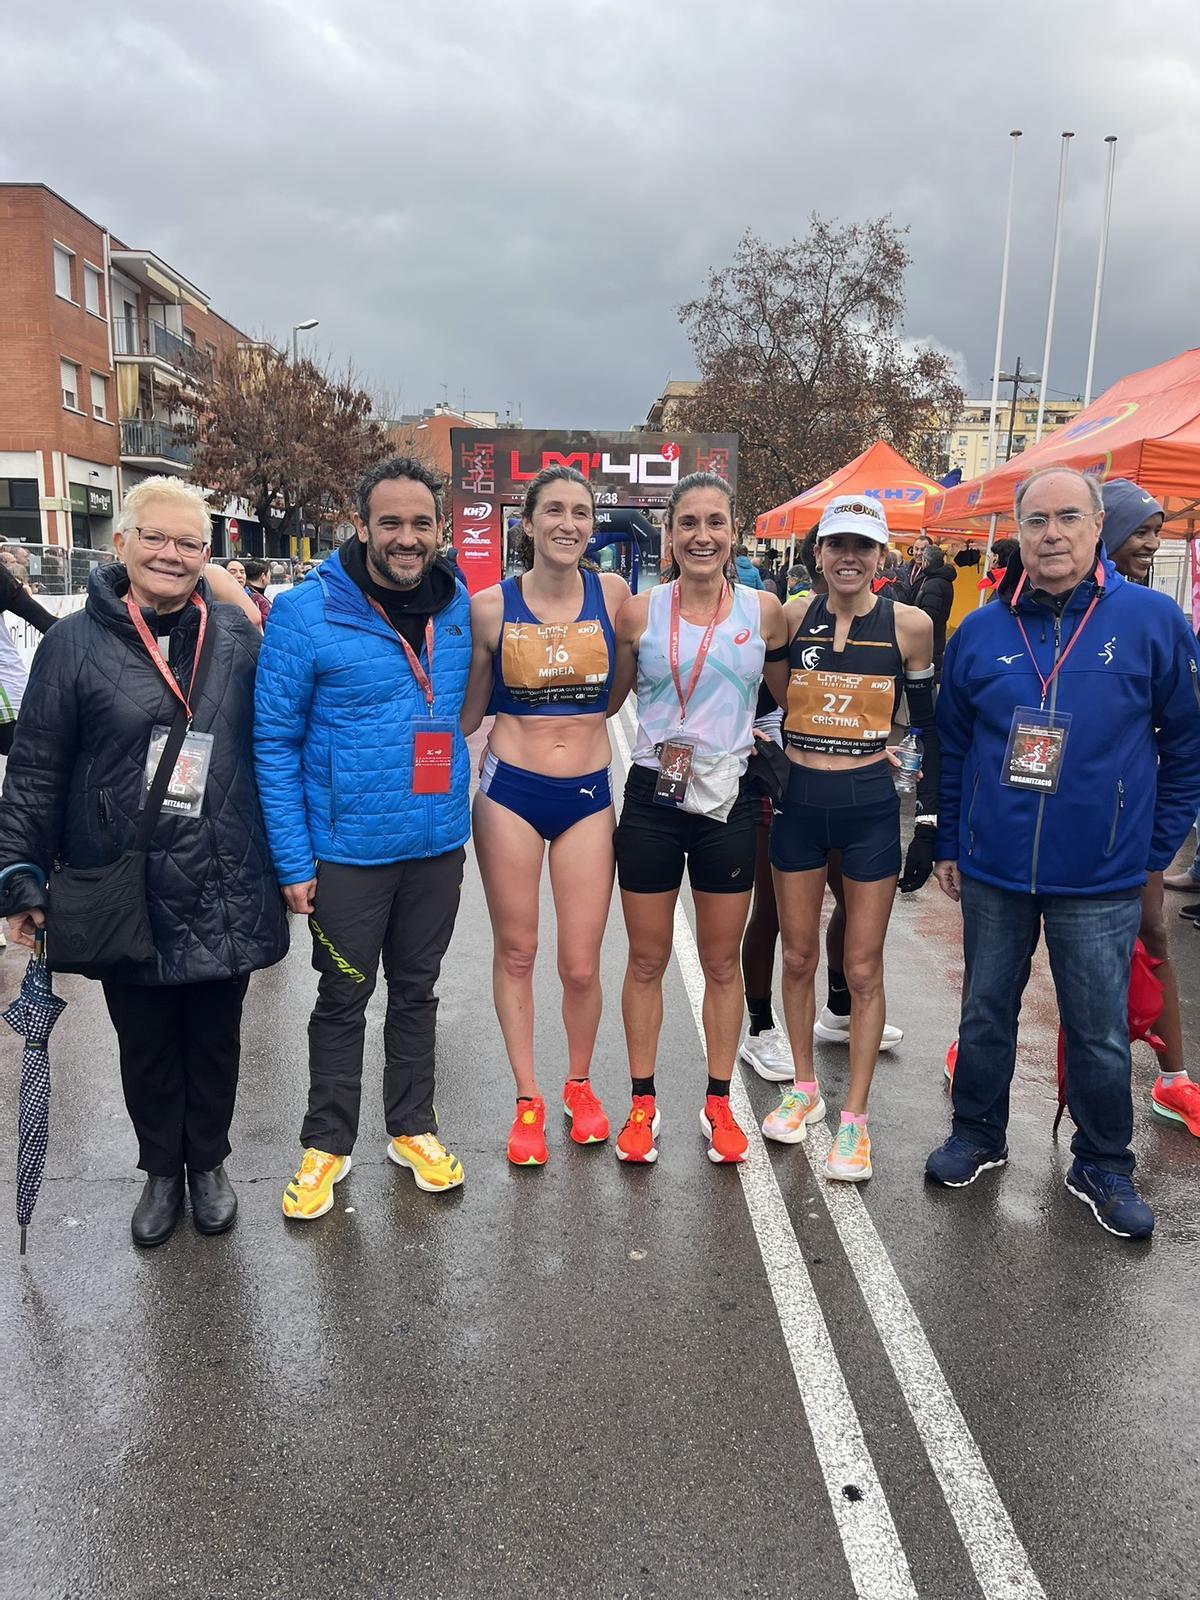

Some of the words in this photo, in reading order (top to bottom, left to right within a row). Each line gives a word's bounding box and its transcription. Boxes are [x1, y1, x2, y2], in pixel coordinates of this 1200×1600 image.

[545, 645, 569, 664] 16
[538, 667, 575, 677] MIREIA
[822, 693, 853, 714] 27
[811, 714, 859, 728] CRISTINA
[1009, 775, 1053, 787] ORGANITZACIÓ
[669, 783, 676, 793] 2
